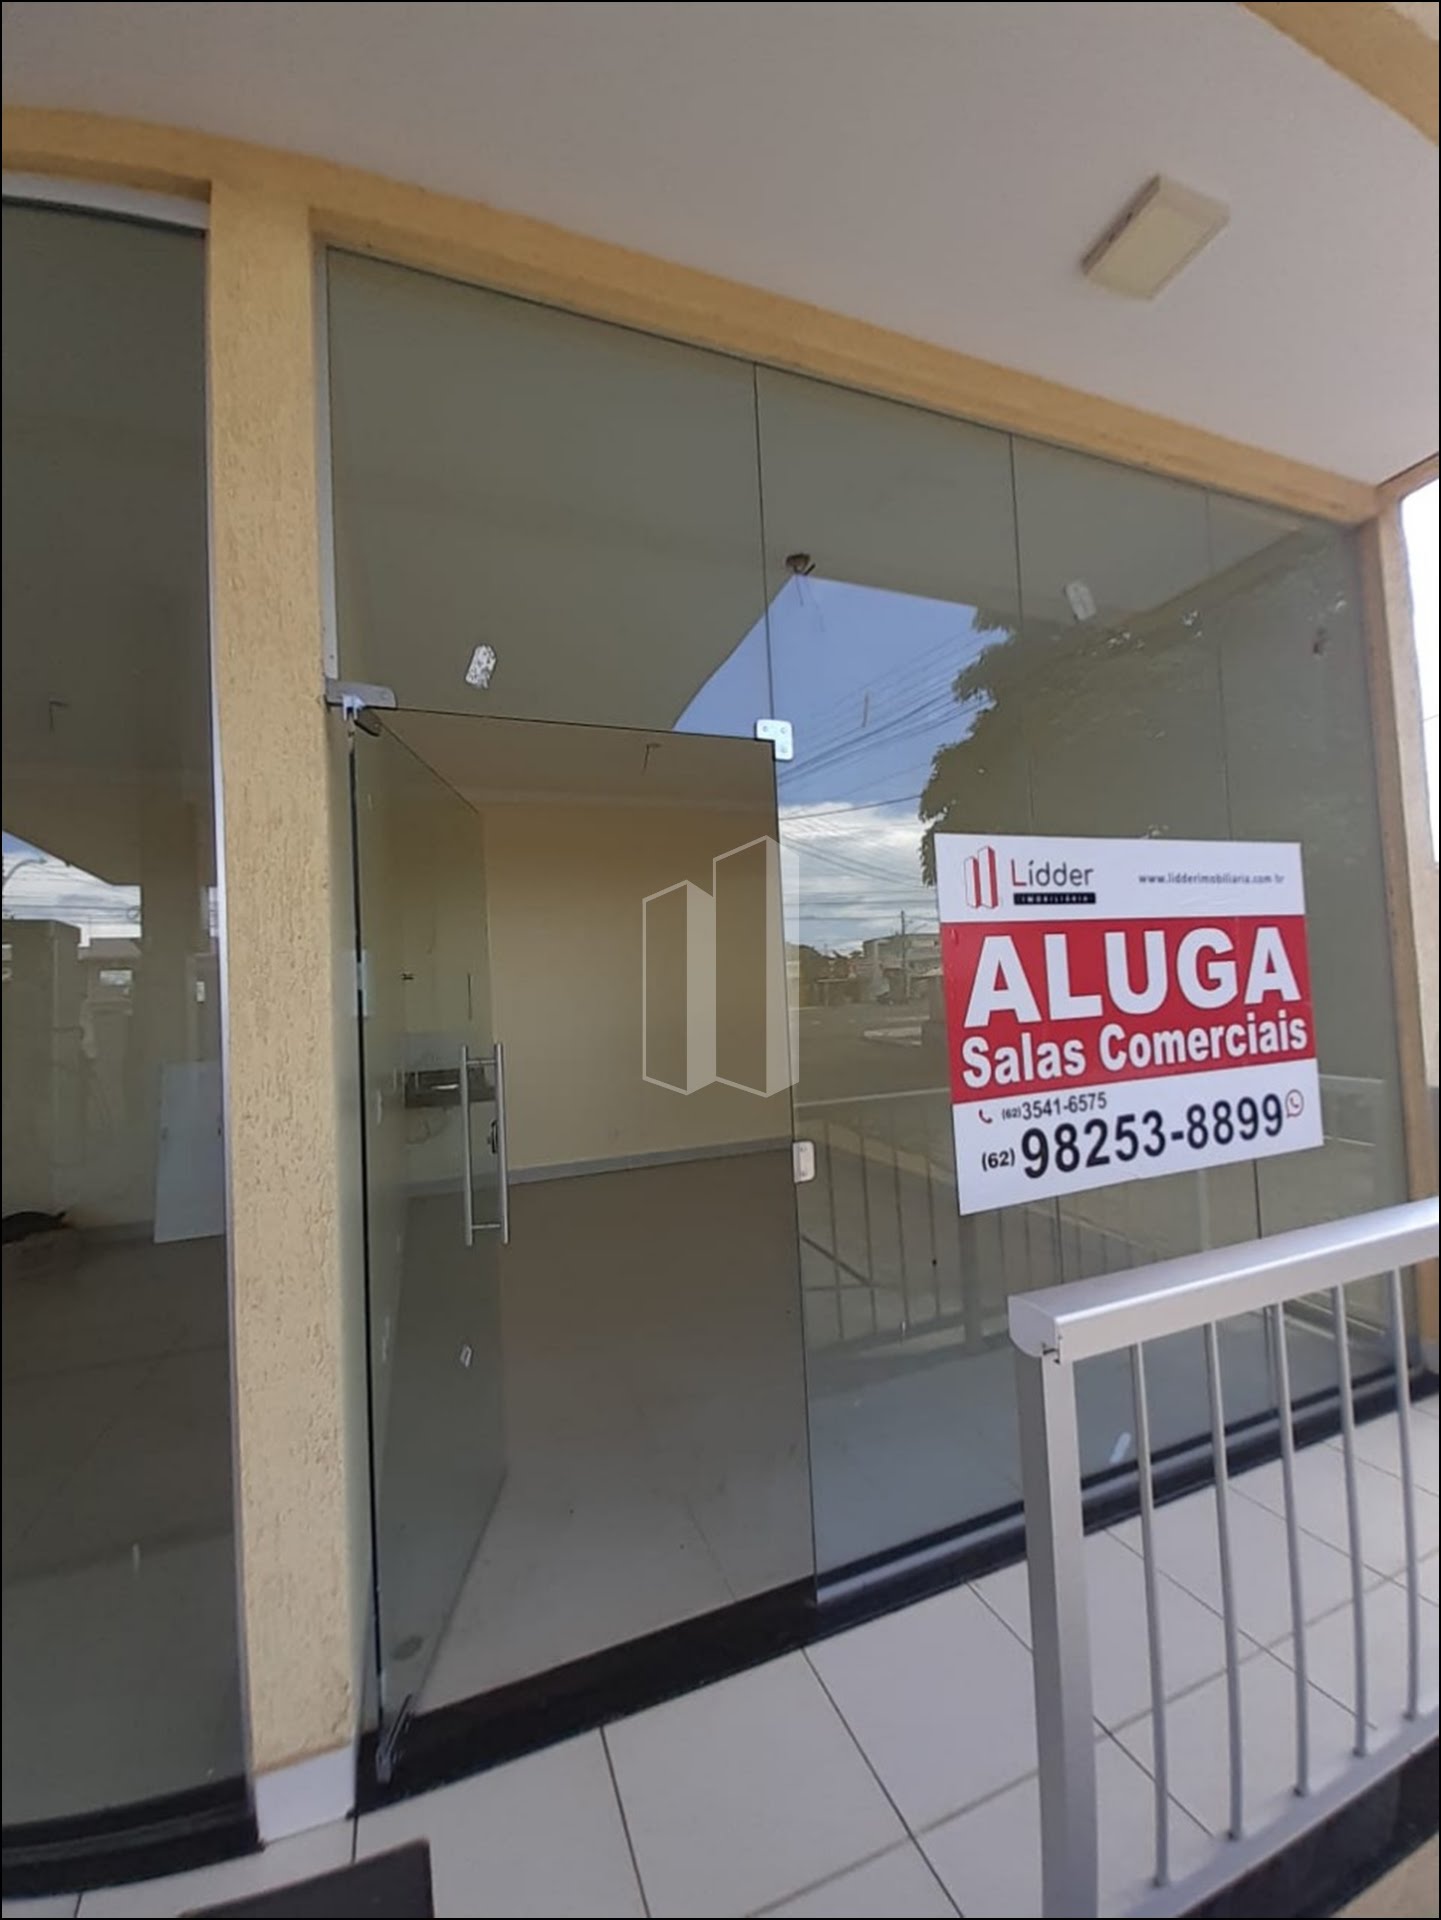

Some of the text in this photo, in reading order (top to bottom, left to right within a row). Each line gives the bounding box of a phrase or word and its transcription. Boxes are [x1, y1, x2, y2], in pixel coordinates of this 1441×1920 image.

[1011, 859, 1094, 887] Lídder
[964, 926, 1302, 1029] ALUGA
[962, 1009, 1308, 1089] Salas Comerciais
[982, 1093, 1284, 1179] (62) 98253-8899
